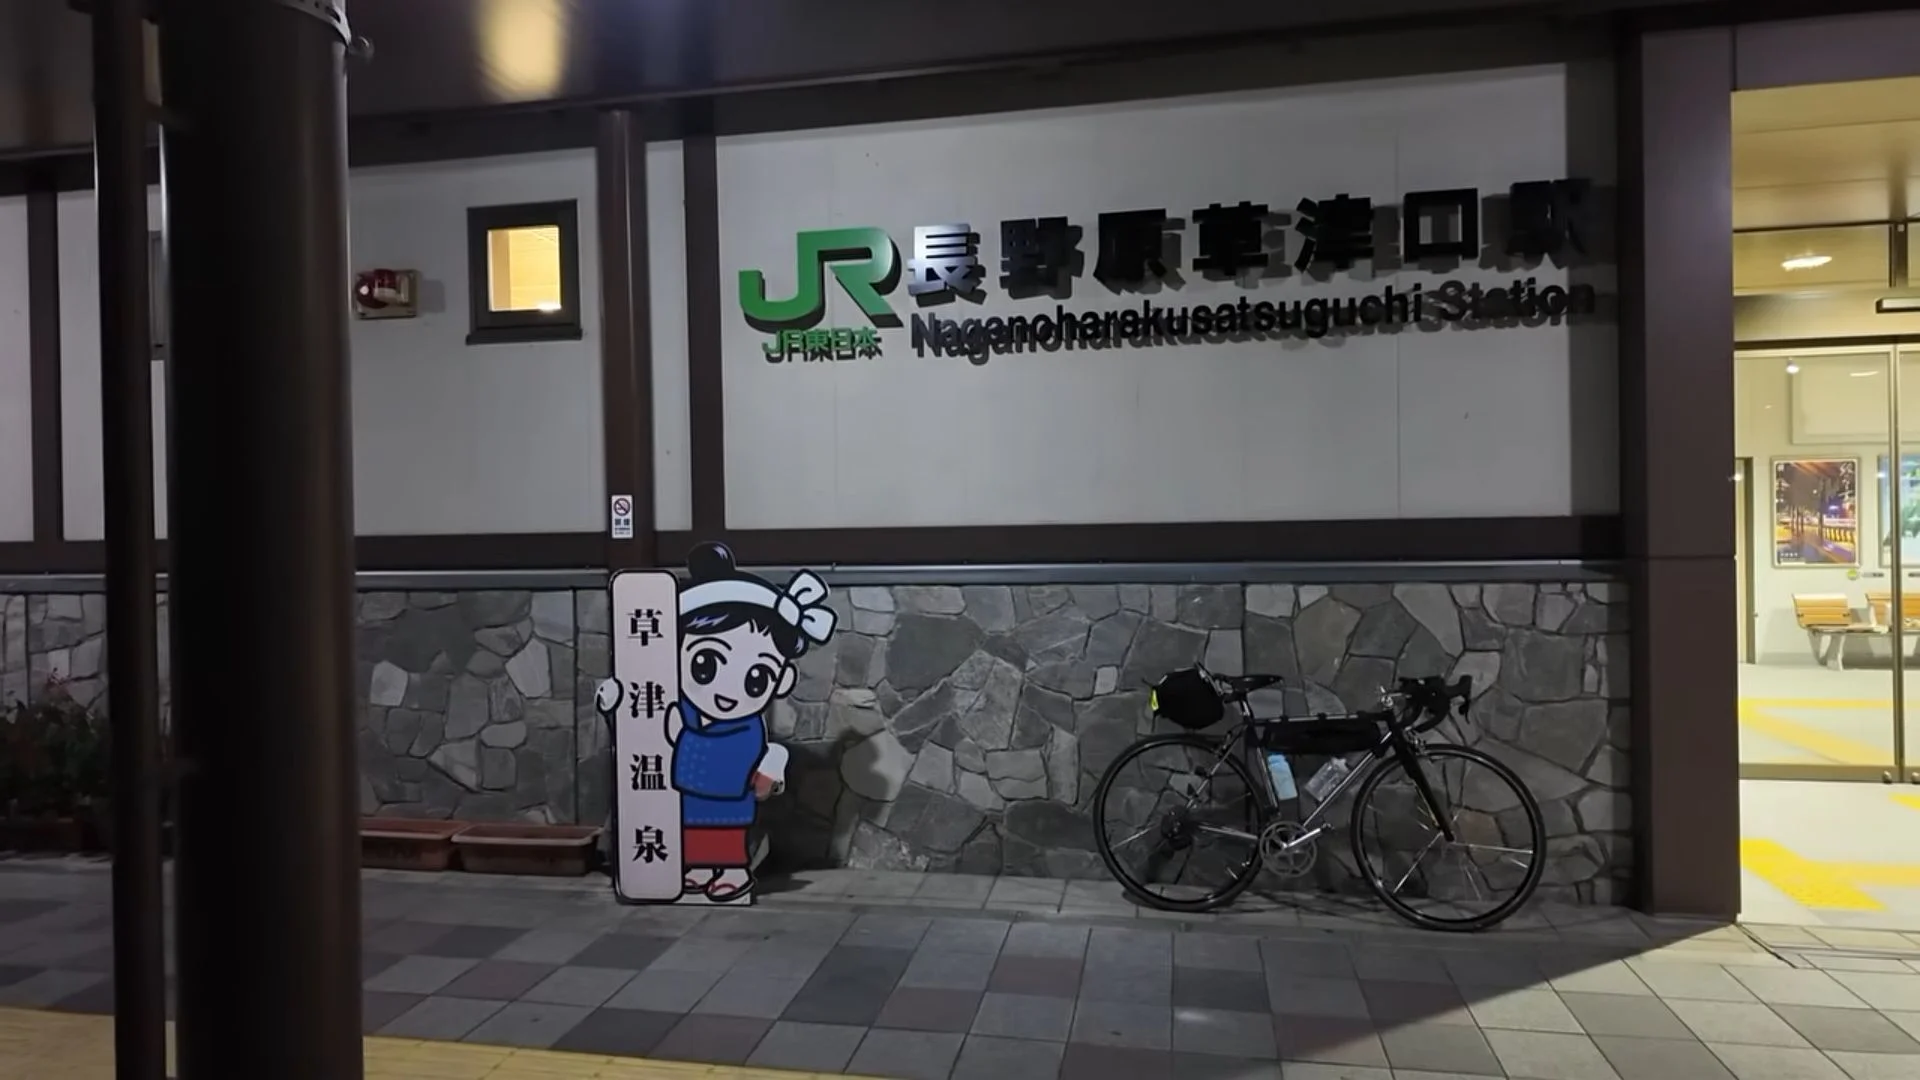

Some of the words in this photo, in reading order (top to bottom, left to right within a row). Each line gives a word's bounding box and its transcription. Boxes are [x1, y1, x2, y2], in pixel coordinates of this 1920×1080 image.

[739, 226, 899, 323] JR
[907, 178, 1591, 296] 長野原草津口駅
[762, 326, 879, 354] JR東日本
[911, 284, 1423, 358] Naganoharakusatsuguchi
[1438, 277, 1595, 321] Station
[626, 608, 669, 864] 草津温泉
